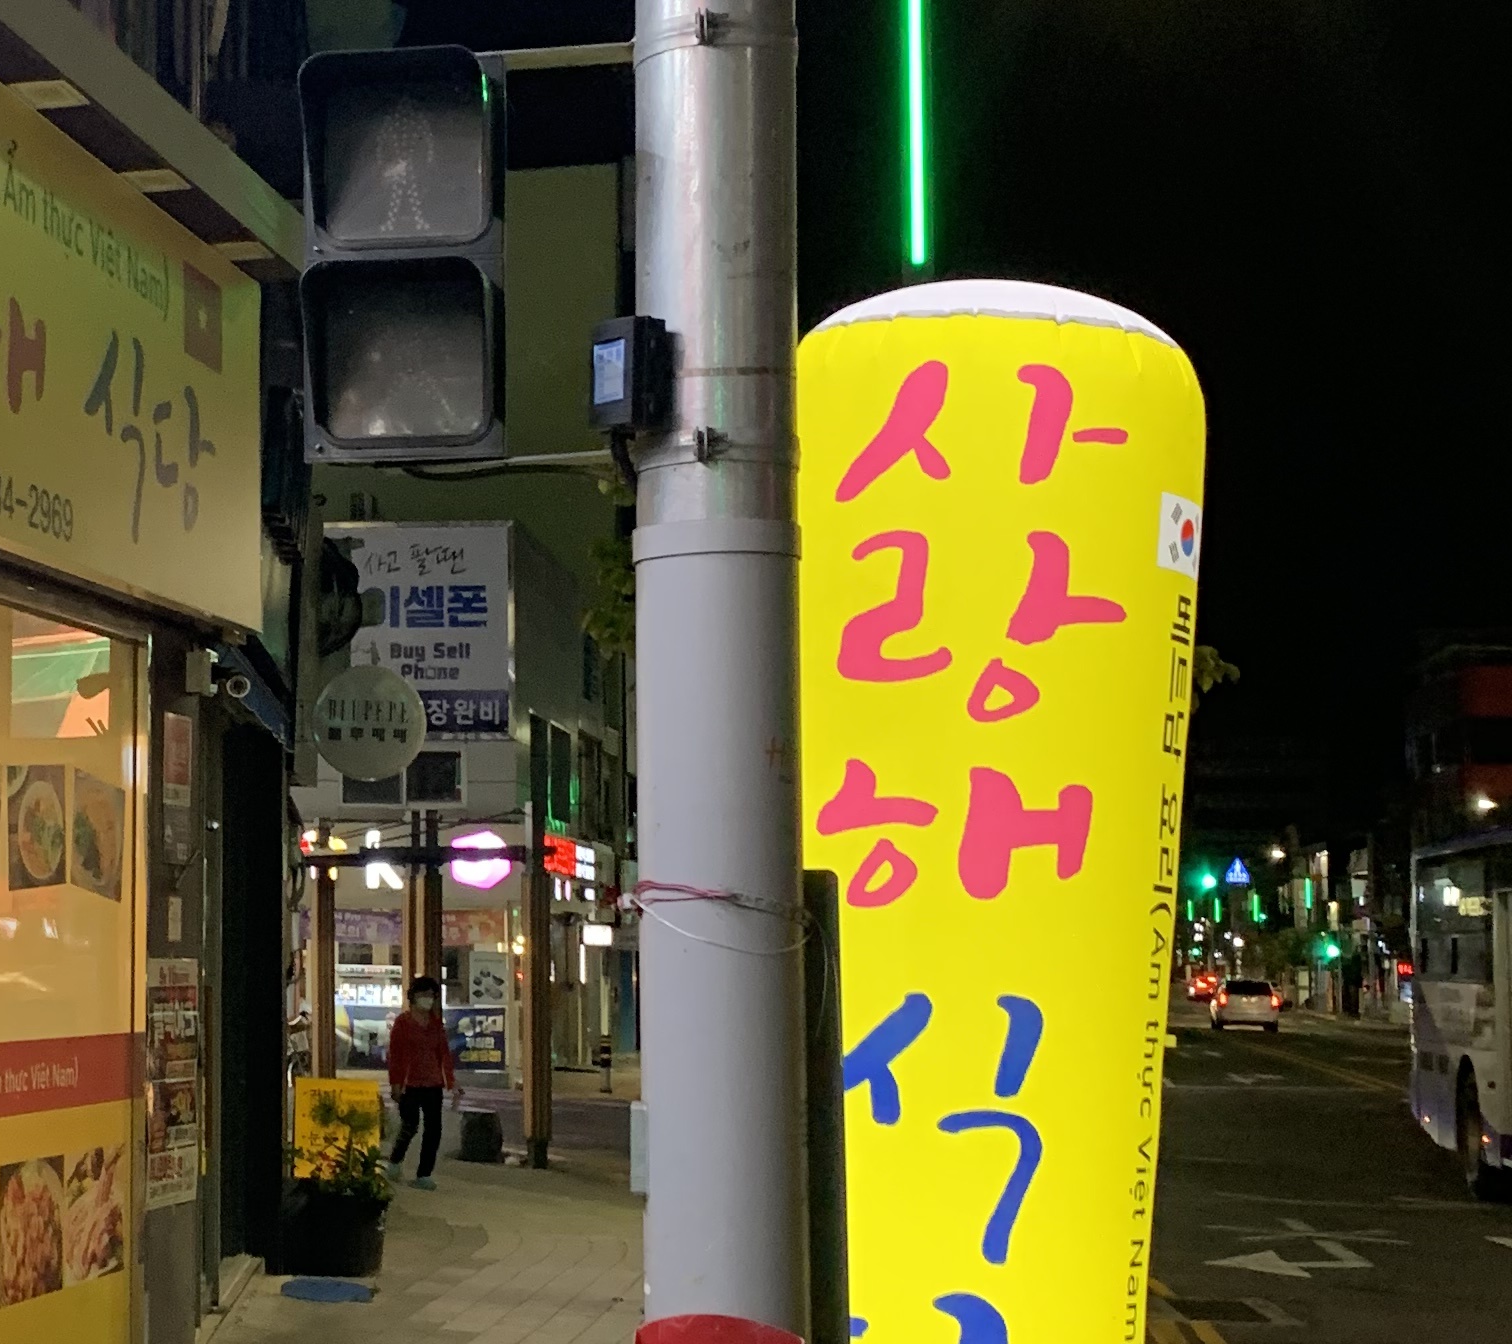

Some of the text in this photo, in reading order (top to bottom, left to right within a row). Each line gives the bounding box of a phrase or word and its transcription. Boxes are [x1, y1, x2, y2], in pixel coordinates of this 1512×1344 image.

[84, 328, 217, 544] 식당
[390, 642, 471, 662] Buy Sell
[401, 664, 460, 680] Phone
[1162, 594, 1192, 763] 베트남
[426, 699, 501, 726] 장완비
